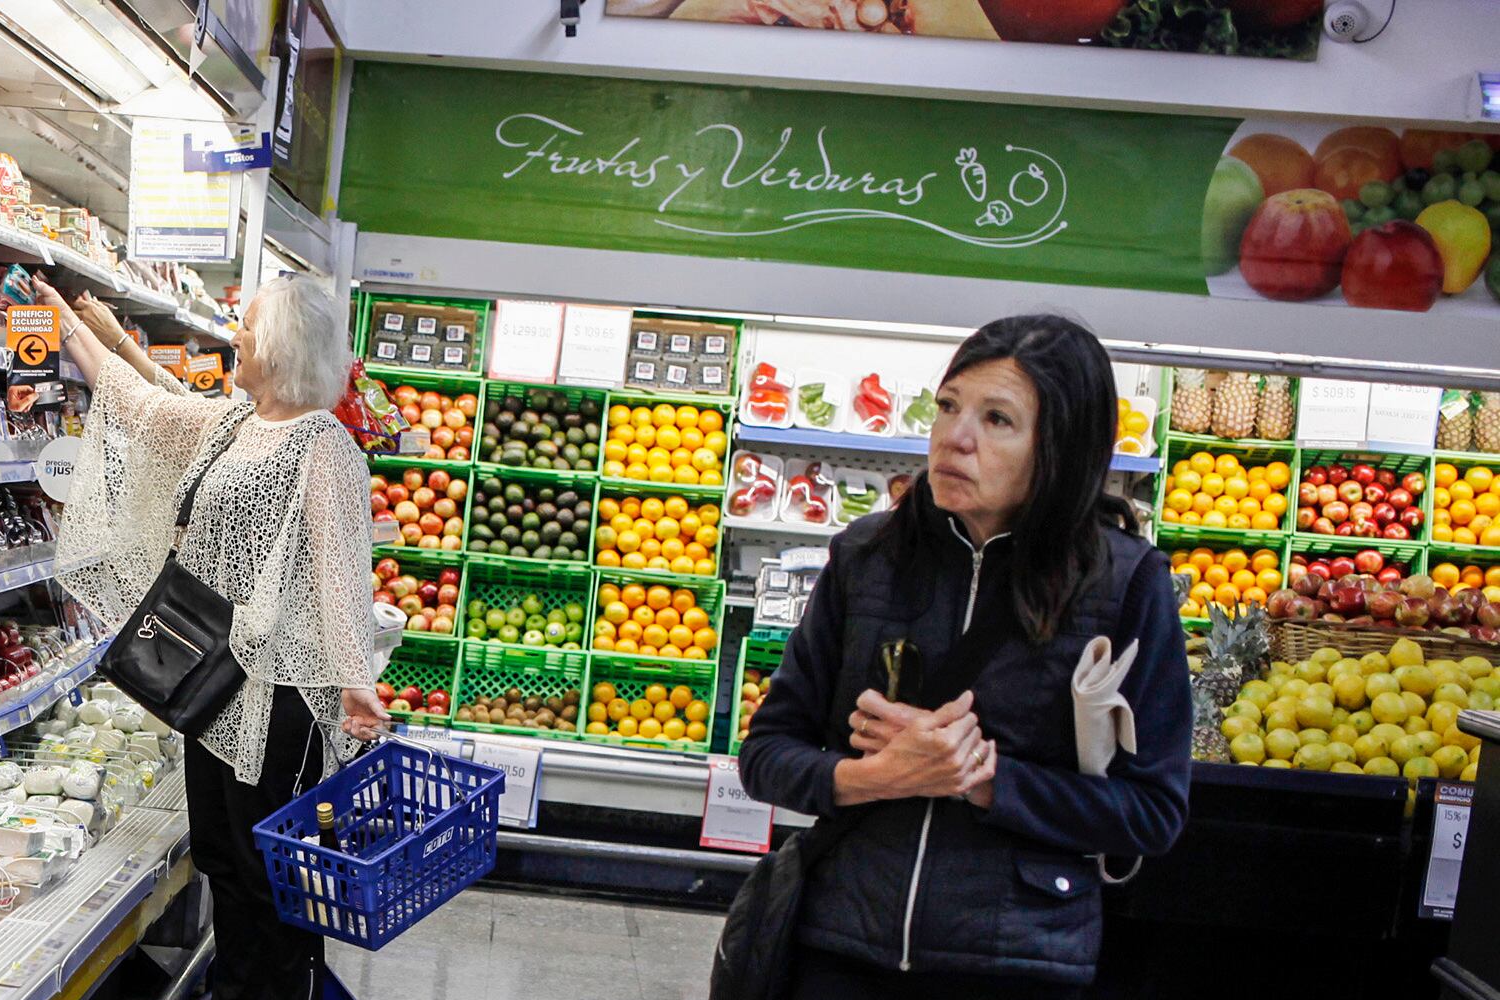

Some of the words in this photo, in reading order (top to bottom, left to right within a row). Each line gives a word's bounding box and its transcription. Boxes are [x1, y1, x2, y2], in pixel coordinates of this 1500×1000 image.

[496, 113, 669, 188] Frutas
[659, 164, 704, 212] y
[696, 124, 937, 204] Verduras
[53, 465, 74, 477] jus
[718, 786, 724, 798] $
[729, 788, 751, 801] 499.
[1440, 786, 1474, 797] COMU
[1444, 809, 1462, 822] 15%
[424, 829, 452, 856] COTO
[1452, 832, 1462, 849] $
